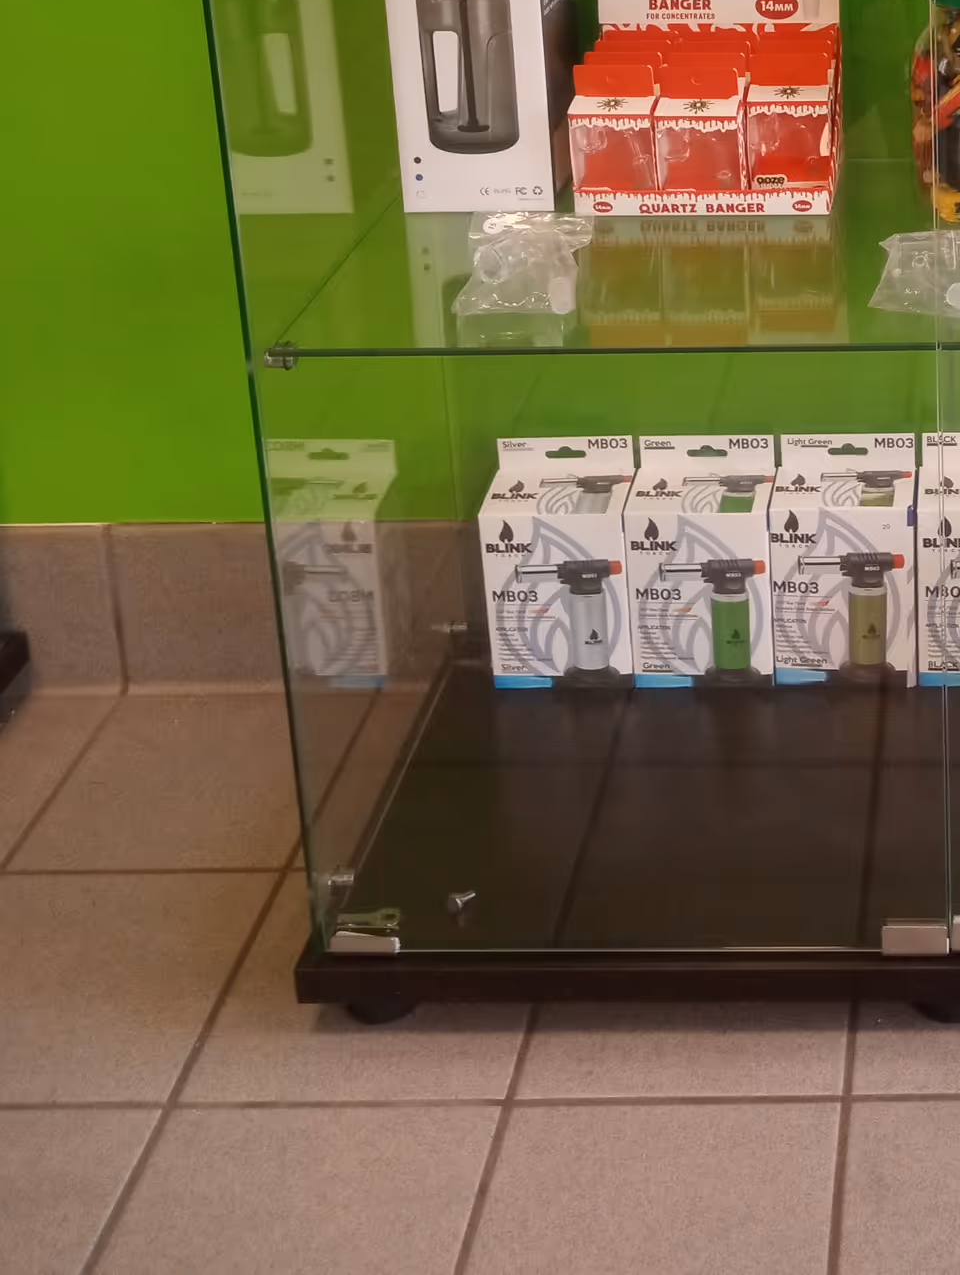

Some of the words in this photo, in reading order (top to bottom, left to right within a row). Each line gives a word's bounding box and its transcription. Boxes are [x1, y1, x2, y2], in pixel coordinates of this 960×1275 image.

[661, 12, 715, 20] CONCENTRATES
[756, 176, 785, 185] ooze
[639, 203, 697, 214] QUARTZ
[706, 202, 765, 213] BANGER
[787, 438, 805, 446] Light
[770, 533, 818, 544] BLINK
[485, 543, 533, 553] BLINK
[630, 540, 677, 551] BLINK
[776, 656, 797, 664] Light
